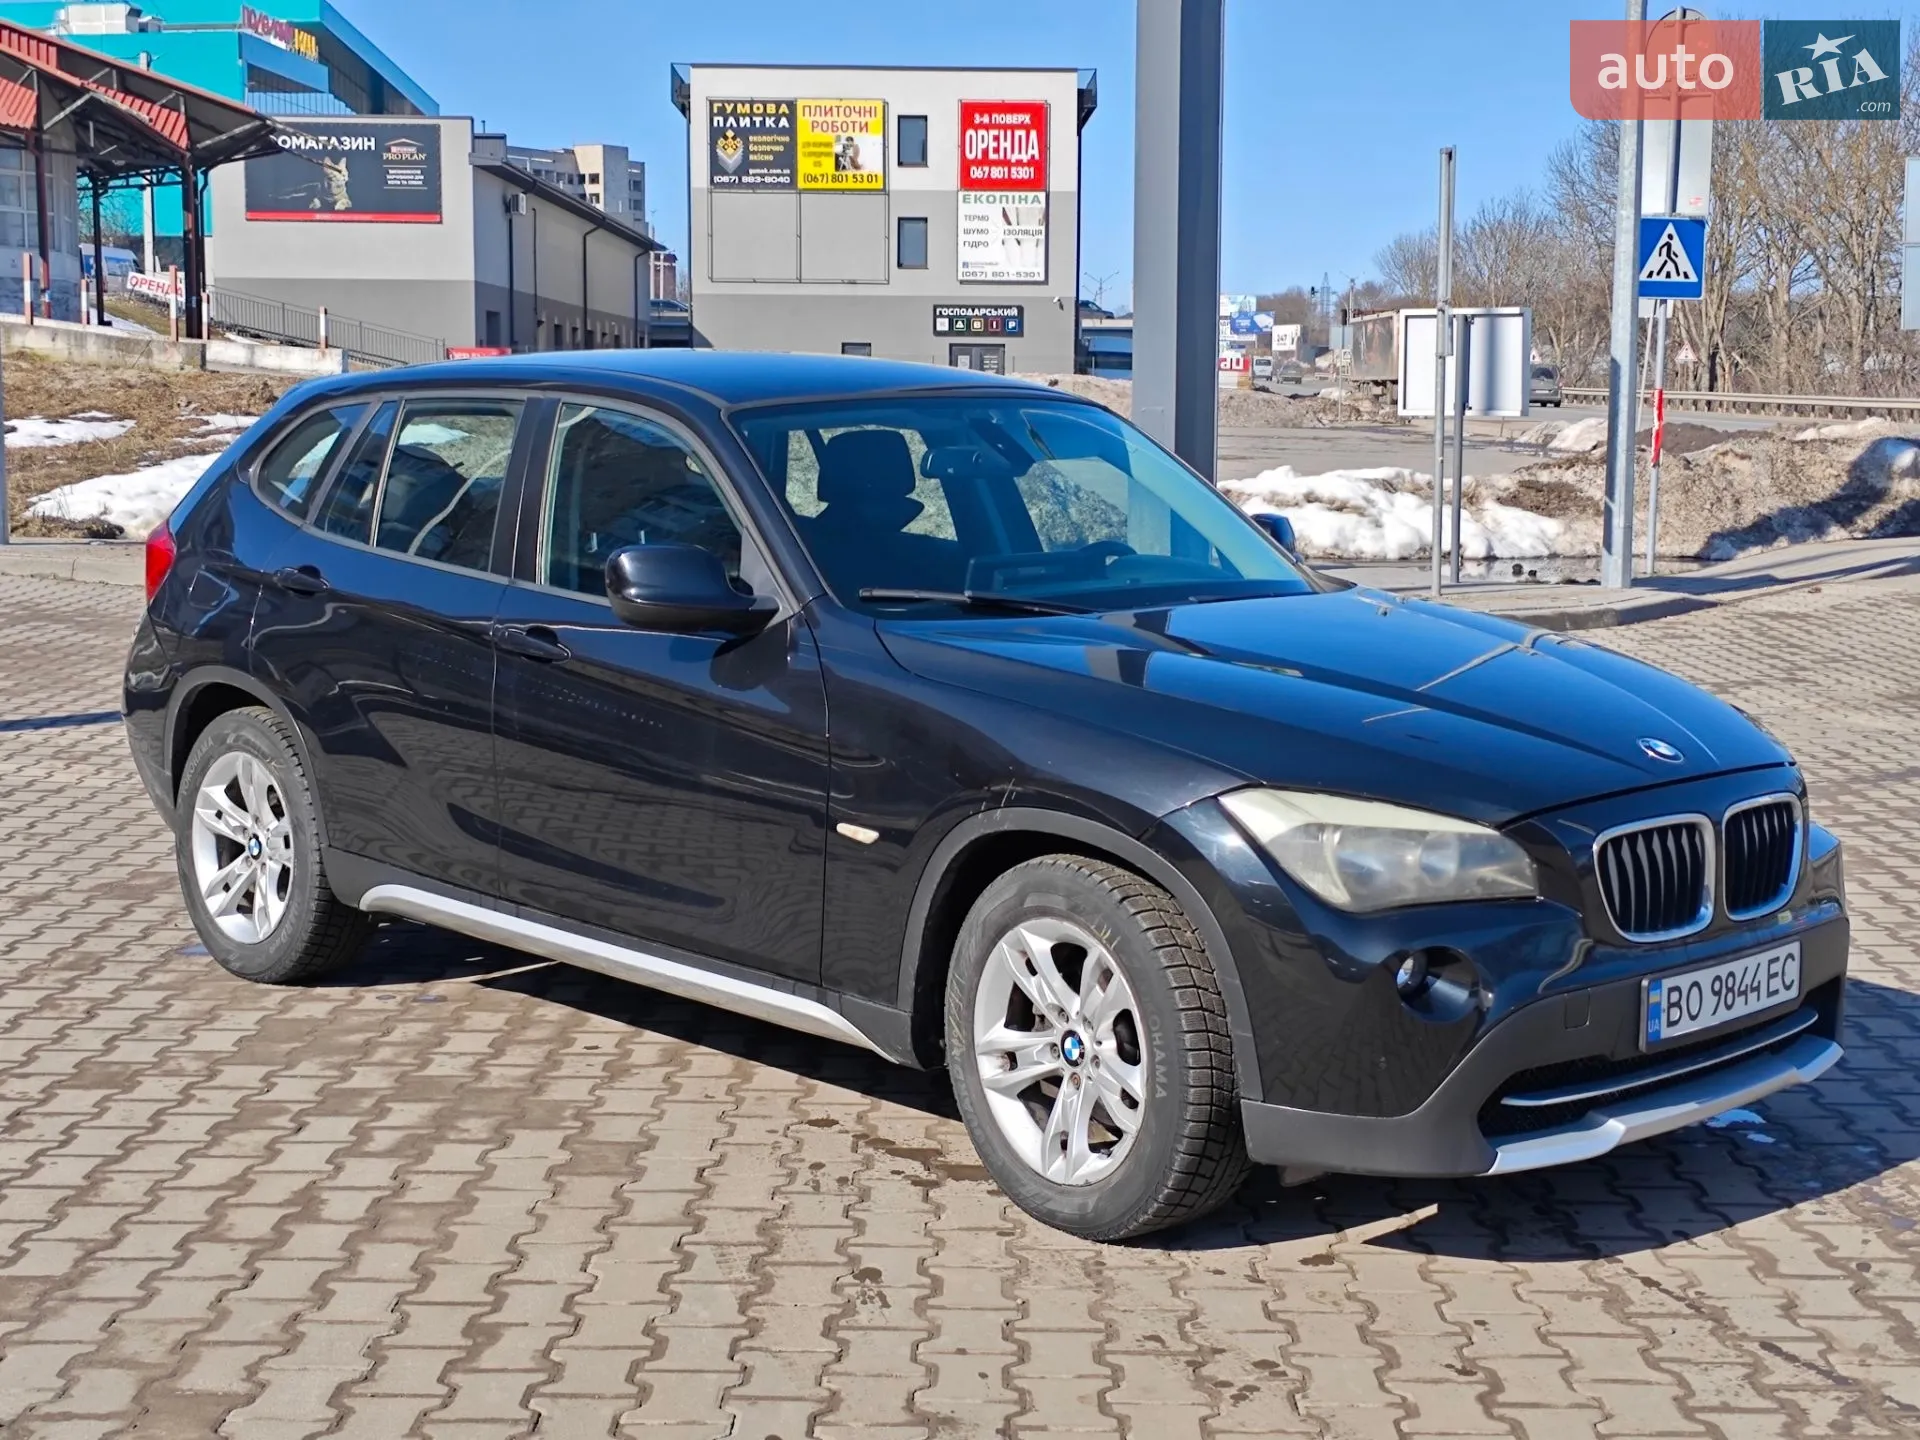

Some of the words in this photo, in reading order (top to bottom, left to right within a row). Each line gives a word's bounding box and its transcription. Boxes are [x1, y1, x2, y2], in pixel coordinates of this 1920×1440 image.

[713, 103, 789, 114] ГУМОВА
[802, 105, 877, 118] ПЛИТОЧНІ
[713, 116, 790, 128] ПЛИТКА
[991, 113, 1031, 124] ПОВЕРХ
[811, 121, 869, 133] РОБОТИ
[270, 135, 376, 151] ОМАГАЗИН
[965, 128, 1040, 163] ОРЕНДА
[382, 152, 402, 160] PRO
[970, 166, 989, 179] 067
[990, 166, 1008, 179] 801
[1010, 166, 1034, 179] 5301
[803, 173, 828, 184] (067)
[831, 174, 848, 183] 801
[852, 174, 865, 183] 53
[867, 174, 878, 183] 01
[962, 194, 1041, 204] ЕКОПІНА
[964, 214, 989, 222] ТЕРМО
[1003, 228, 1043, 237] ІЗОЛЯЦІЯ
[963, 241, 989, 249] ГІДРО
[936, 307, 1018, 316] ГОСПОДАРСЬКИЙ
[1666, 980, 1703, 1028] BO
[1710, 962, 1761, 1016] 9844
[1767, 952, 1796, 999] EC
[1648, 1017, 1660, 1033] UA
